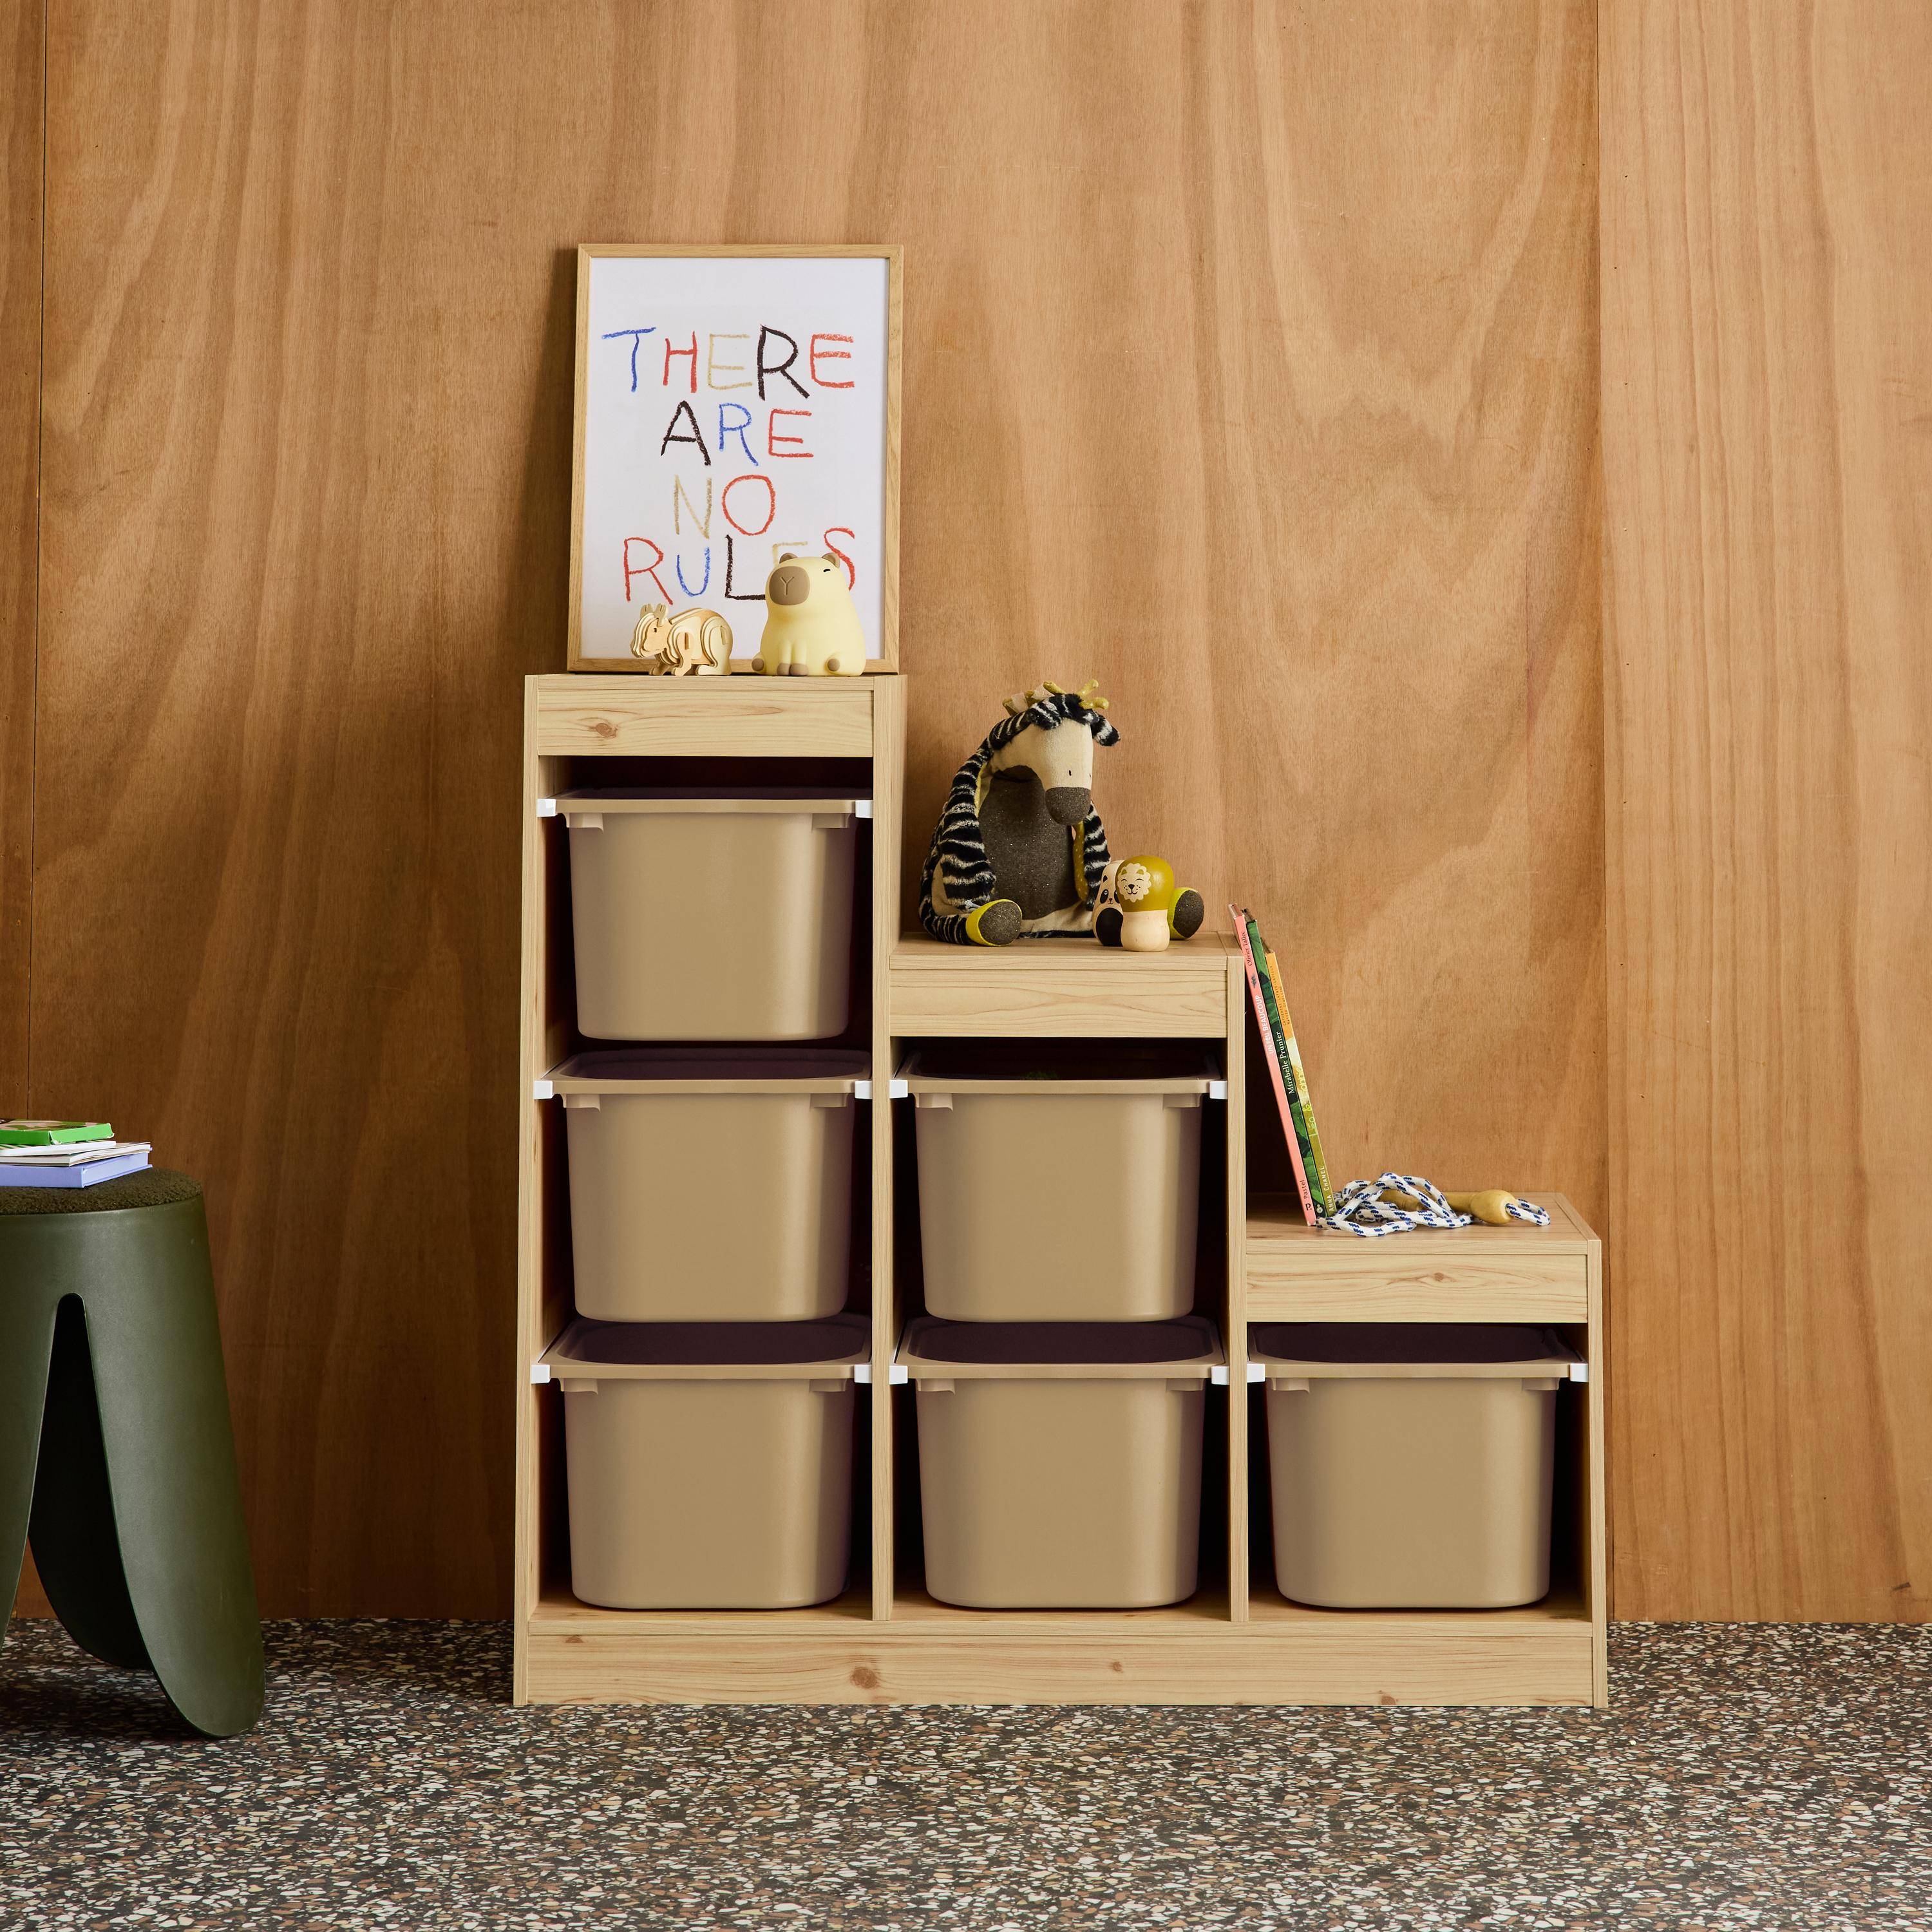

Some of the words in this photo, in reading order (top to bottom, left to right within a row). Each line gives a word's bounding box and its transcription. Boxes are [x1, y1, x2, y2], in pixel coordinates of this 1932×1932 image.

[601, 325, 855, 401] THERE
[661, 401, 814, 467] ARE
[674, 474, 776, 539] NO
[1255, 995, 1269, 1031] BEAUCOUP
[1267, 1045, 1274, 1054] UN
[1276, 1031, 1286, 1059] Prunier
[1282, 1061, 1294, 1094] Mirabelle
[1320, 1166, 1330, 1191] CHANEL
[1327, 1195, 1335, 1211] ANNA
